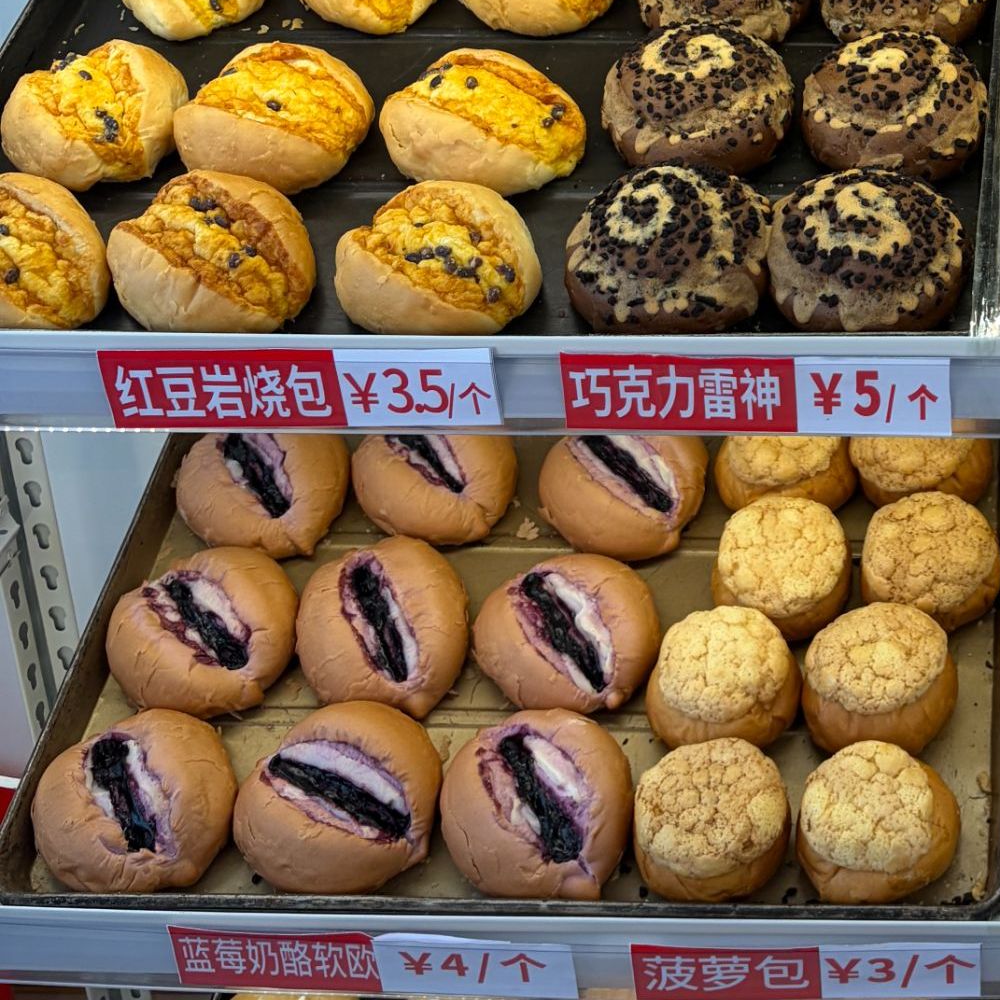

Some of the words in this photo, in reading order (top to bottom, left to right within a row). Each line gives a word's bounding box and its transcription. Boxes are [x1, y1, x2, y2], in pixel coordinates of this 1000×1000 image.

[115, 364, 332, 419] 红豆岩烧包
[570, 365, 780, 419] 巧克力雷神
[178, 936, 379, 980] 蓝莓奶酪软欧
[643, 955, 809, 991] 菠萝包
